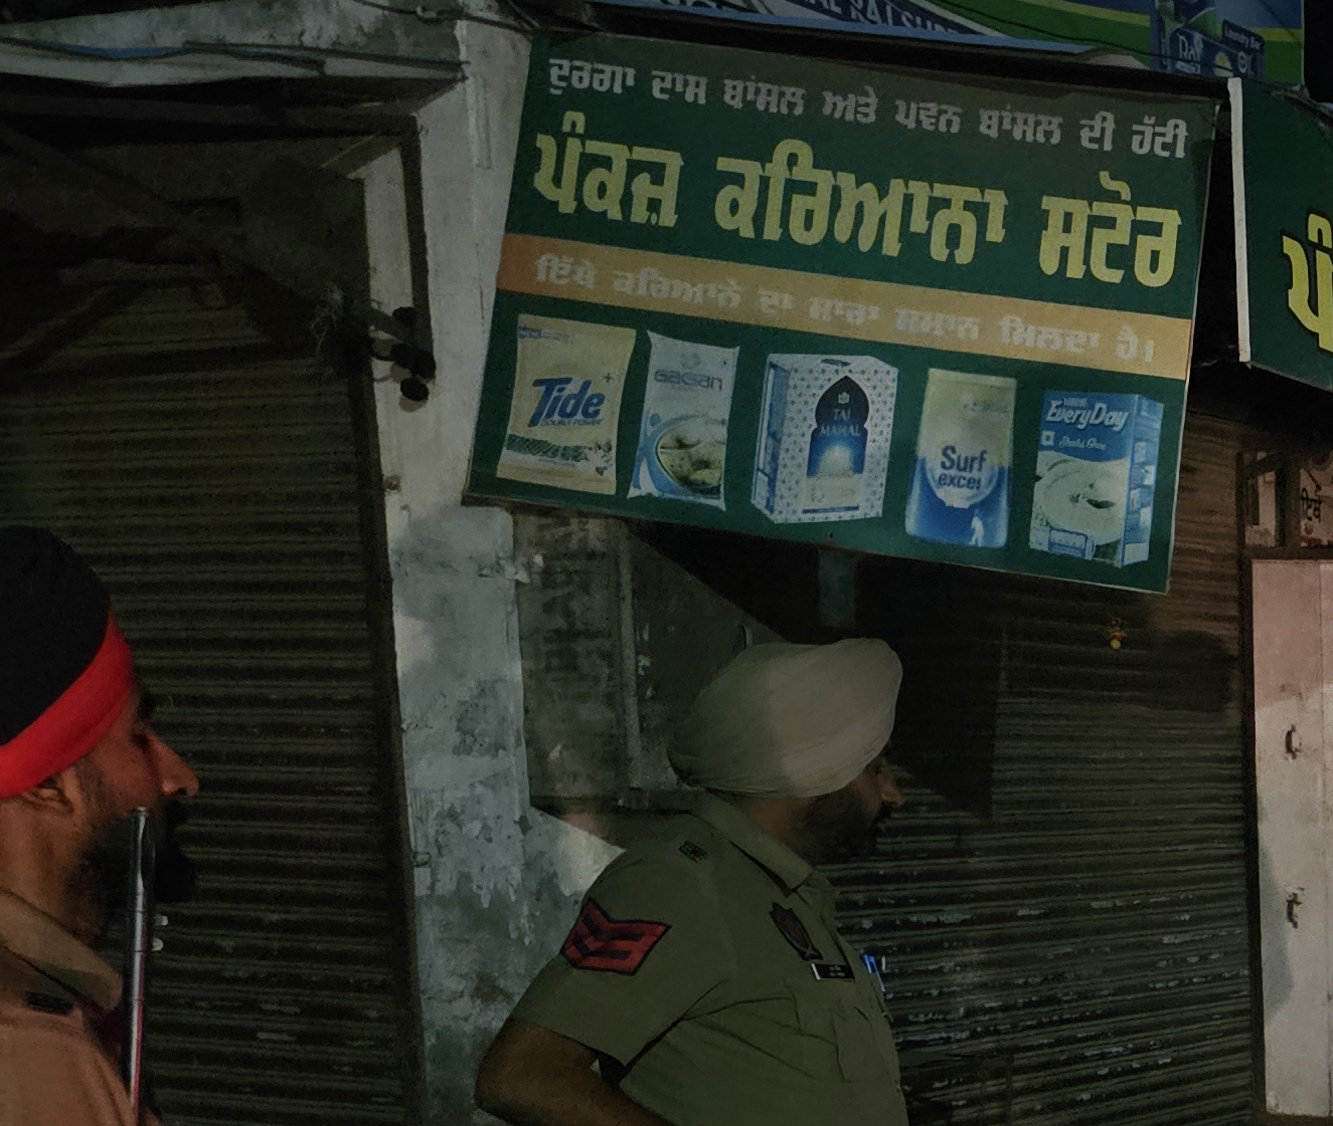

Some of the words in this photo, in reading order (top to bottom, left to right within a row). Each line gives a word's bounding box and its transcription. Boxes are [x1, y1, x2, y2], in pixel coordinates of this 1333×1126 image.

[548, 58, 635, 95] ਦੁਰਗਾ
[651, 70, 708, 105] ਦਾਸ
[724, 74, 806, 116] ਬਾਂਸਲ
[822, 86, 879, 124] ਅਤੇ
[895, 99, 961, 133] ਪਵਨ
[979, 104, 1063, 145] ਬਾਂਸਲ
[1080, 111, 1117, 151] ਦੀ
[1131, 116, 1189, 158] ਹੱਟੀ
[533, 111, 685, 227] ਪੰਕਜ਼
[714, 140, 1009, 264] ਕਰਿਆਨਾ
[1037, 171, 1183, 288] ਸਟੋਰ
[759, 289, 795, 315] ਦਾ
[528, 374, 605, 427] Tide
[941, 445, 988, 473] Surf
